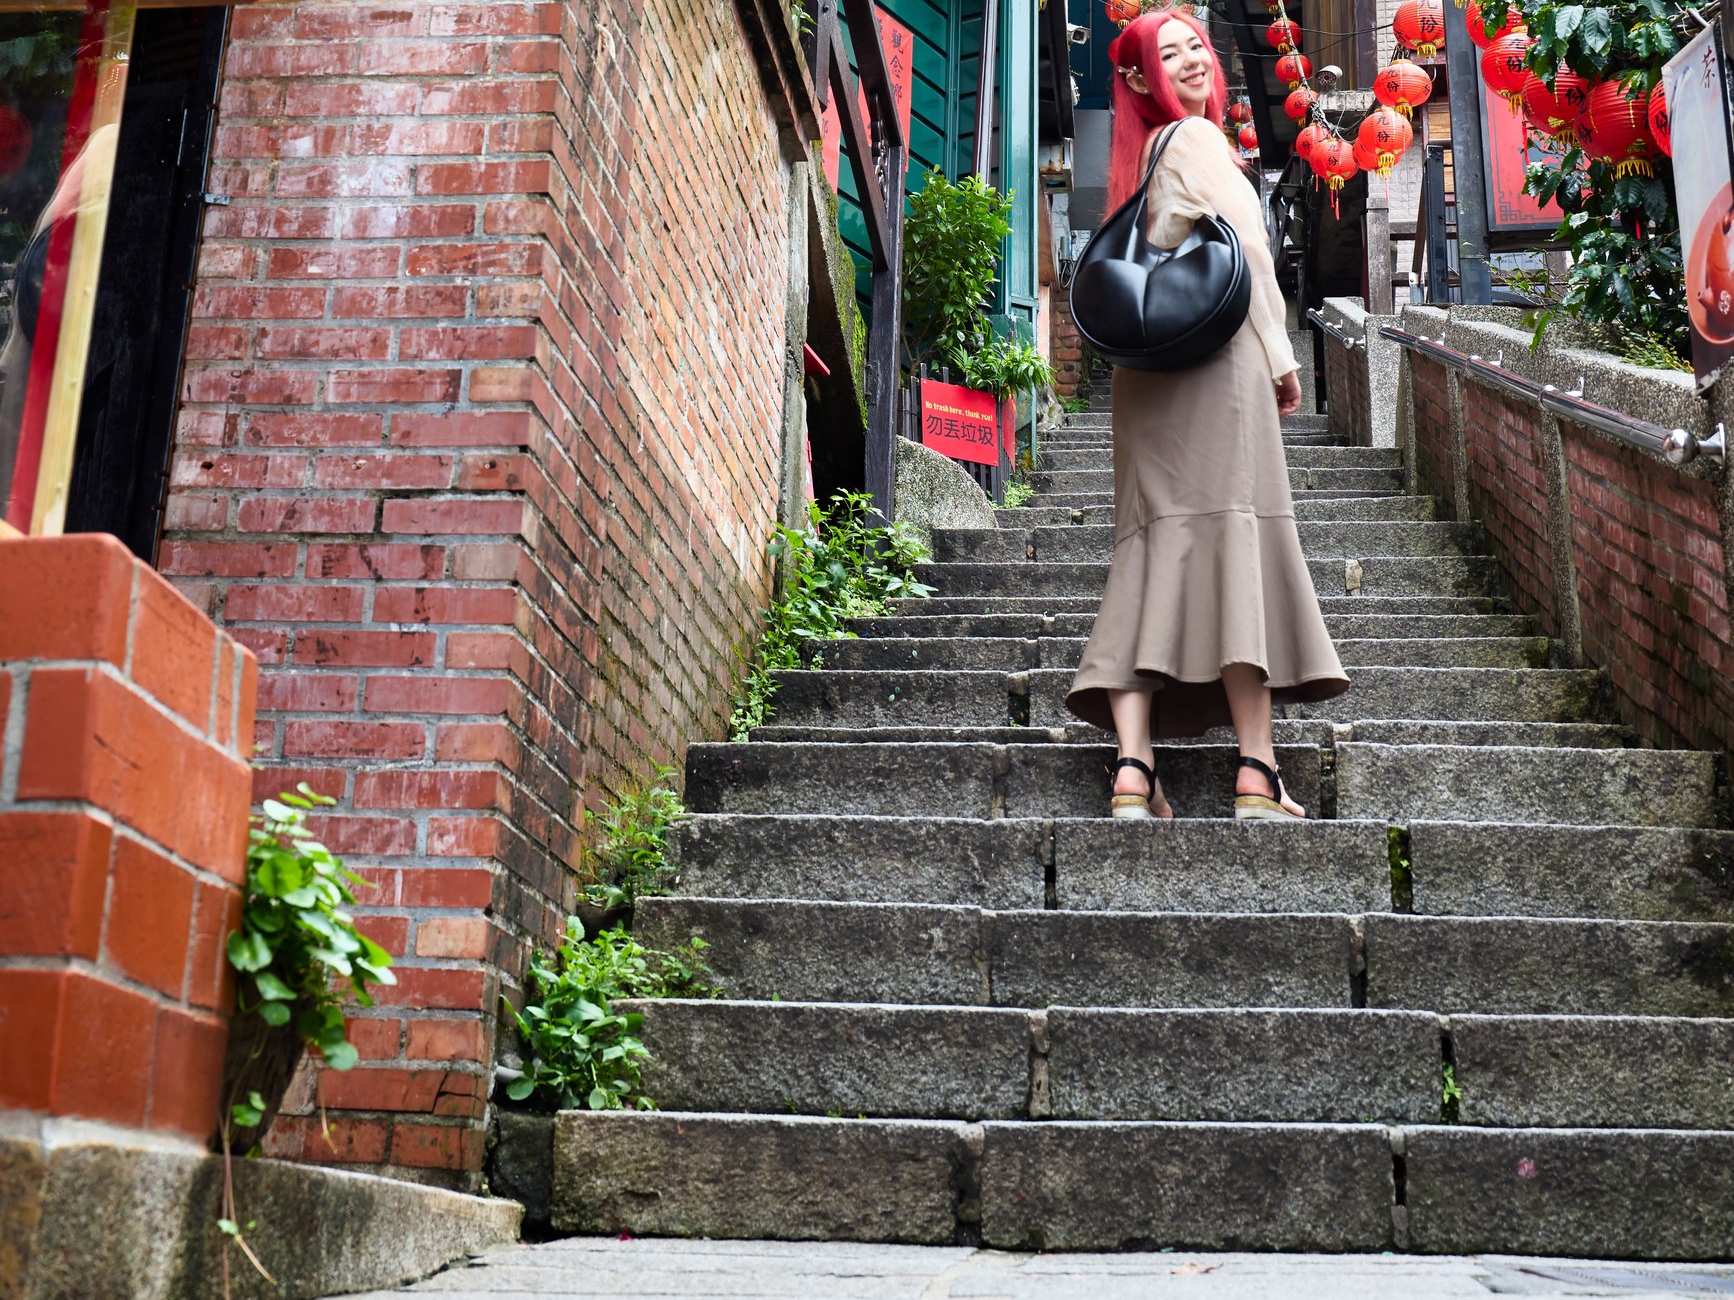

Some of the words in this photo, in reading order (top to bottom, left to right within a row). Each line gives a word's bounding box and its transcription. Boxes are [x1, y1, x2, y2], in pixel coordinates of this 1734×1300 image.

[1418, 0, 1438, 33] 九份
[1386, 68, 1399, 93] 九份
[1377, 115, 1390, 142] 九份
[1327, 143, 1339, 166] 九份
[925, 401, 932, 409] No
[933, 403, 948, 412] trash
[965, 409, 980, 419] thank
[926, 414, 994, 447] 勿丟垃圾
